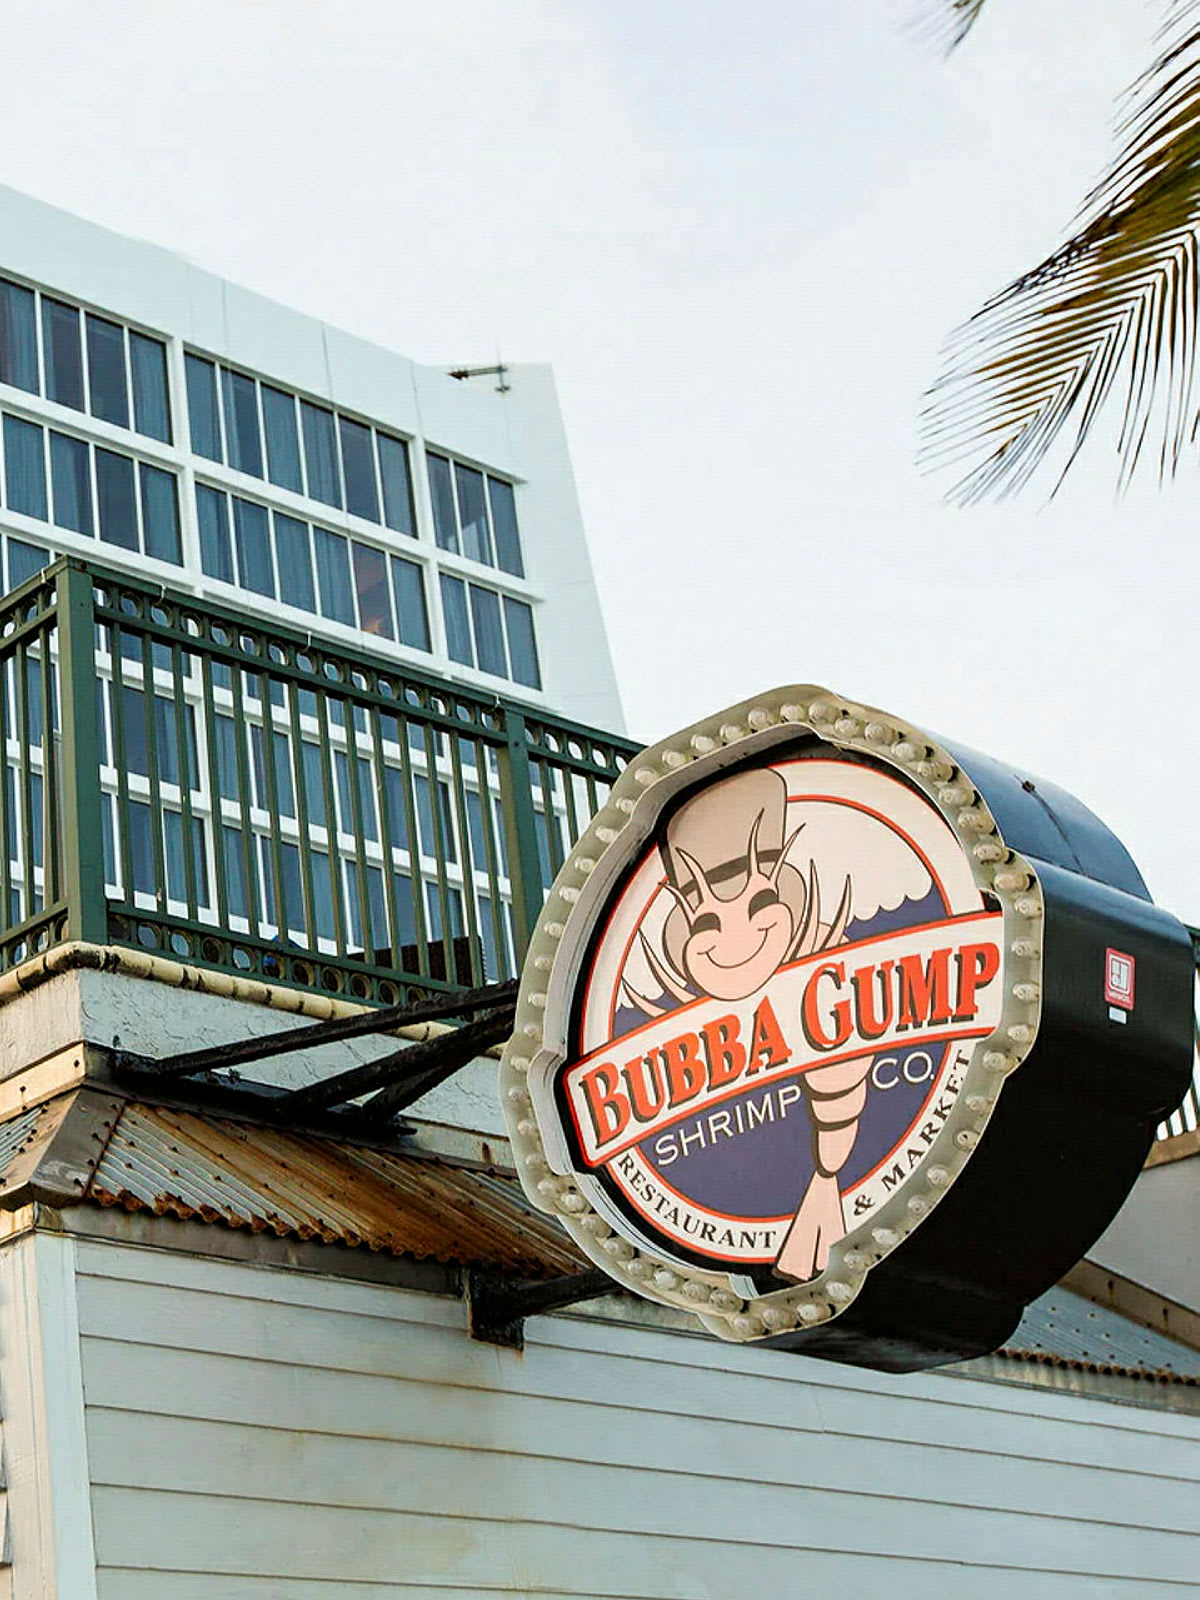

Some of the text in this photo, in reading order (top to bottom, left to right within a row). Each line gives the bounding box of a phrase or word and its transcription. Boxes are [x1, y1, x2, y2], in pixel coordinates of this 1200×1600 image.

[579, 942, 1000, 1149] BUBBA GUMP
[655, 1051, 935, 1166] SHRIMP CO.
[618, 1049, 970, 1249] RESTAURANT & MARKET
